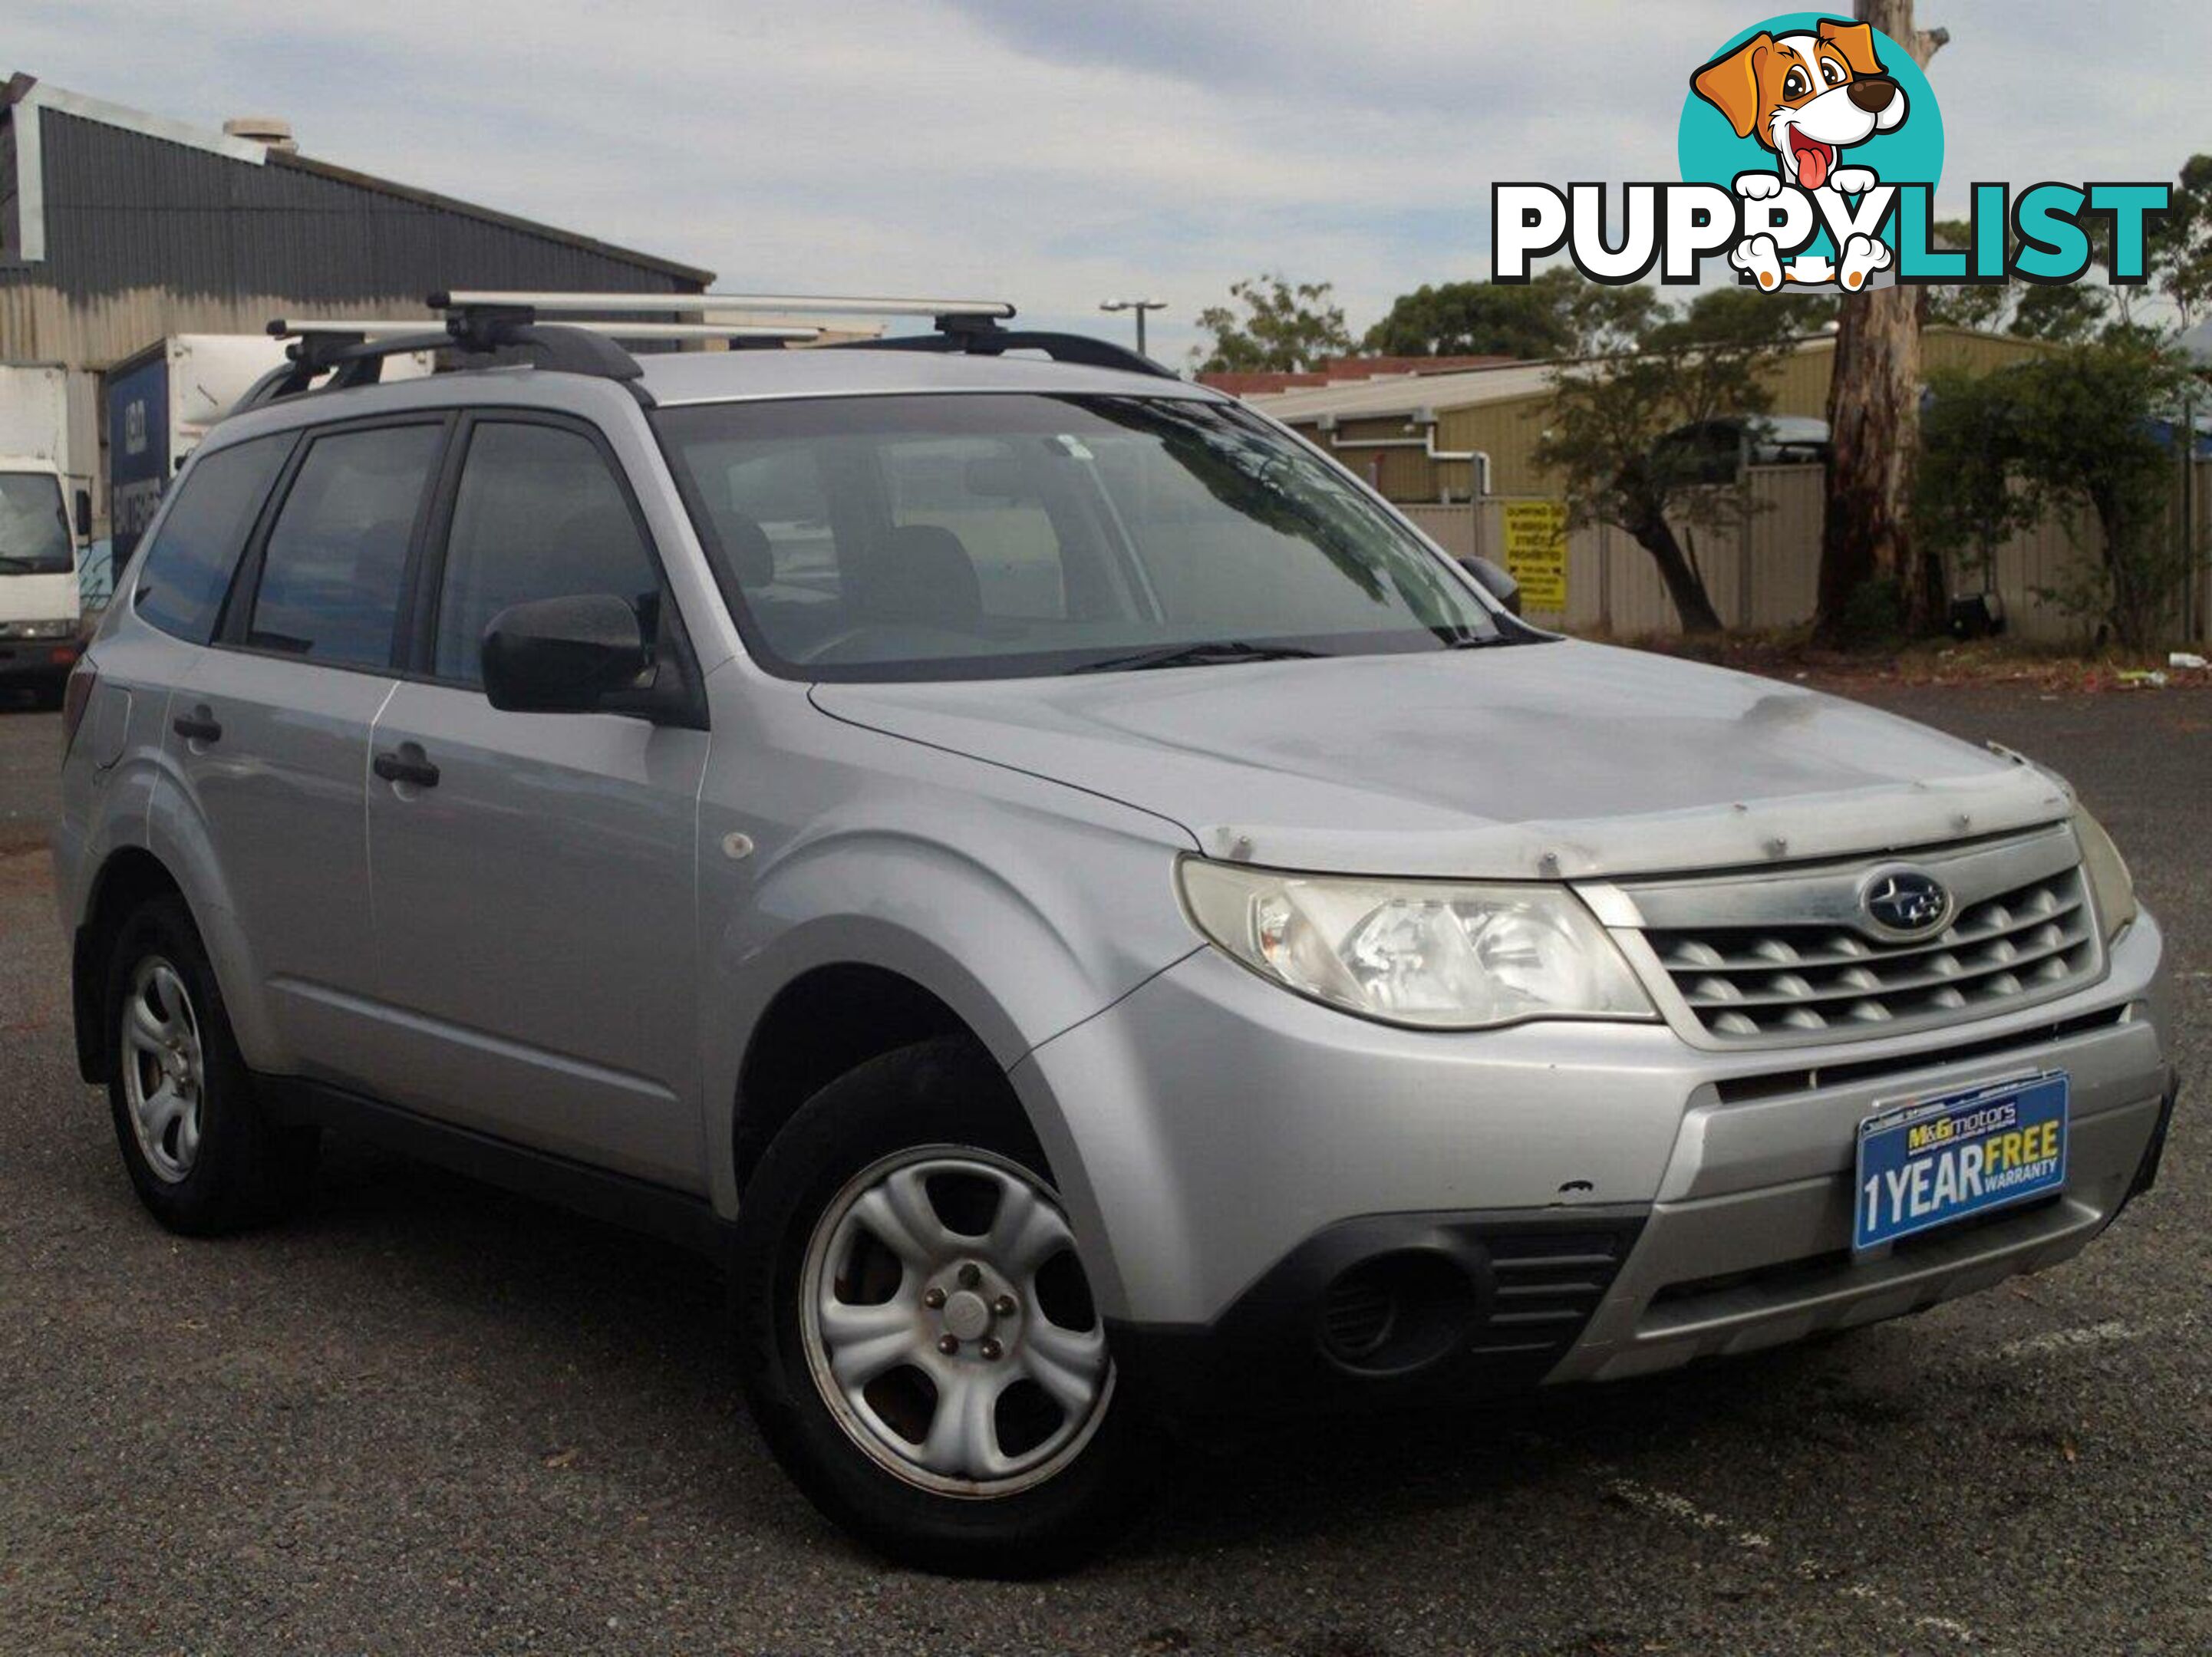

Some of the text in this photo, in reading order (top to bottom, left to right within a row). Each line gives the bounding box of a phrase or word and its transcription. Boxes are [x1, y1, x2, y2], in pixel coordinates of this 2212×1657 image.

[1864, 1174, 1879, 1232] 1
[1884, 1144, 1983, 1224] YEAR
[1984, 1119, 2059, 1175] FREE
[1984, 1156, 2058, 1193] WARRANTY
